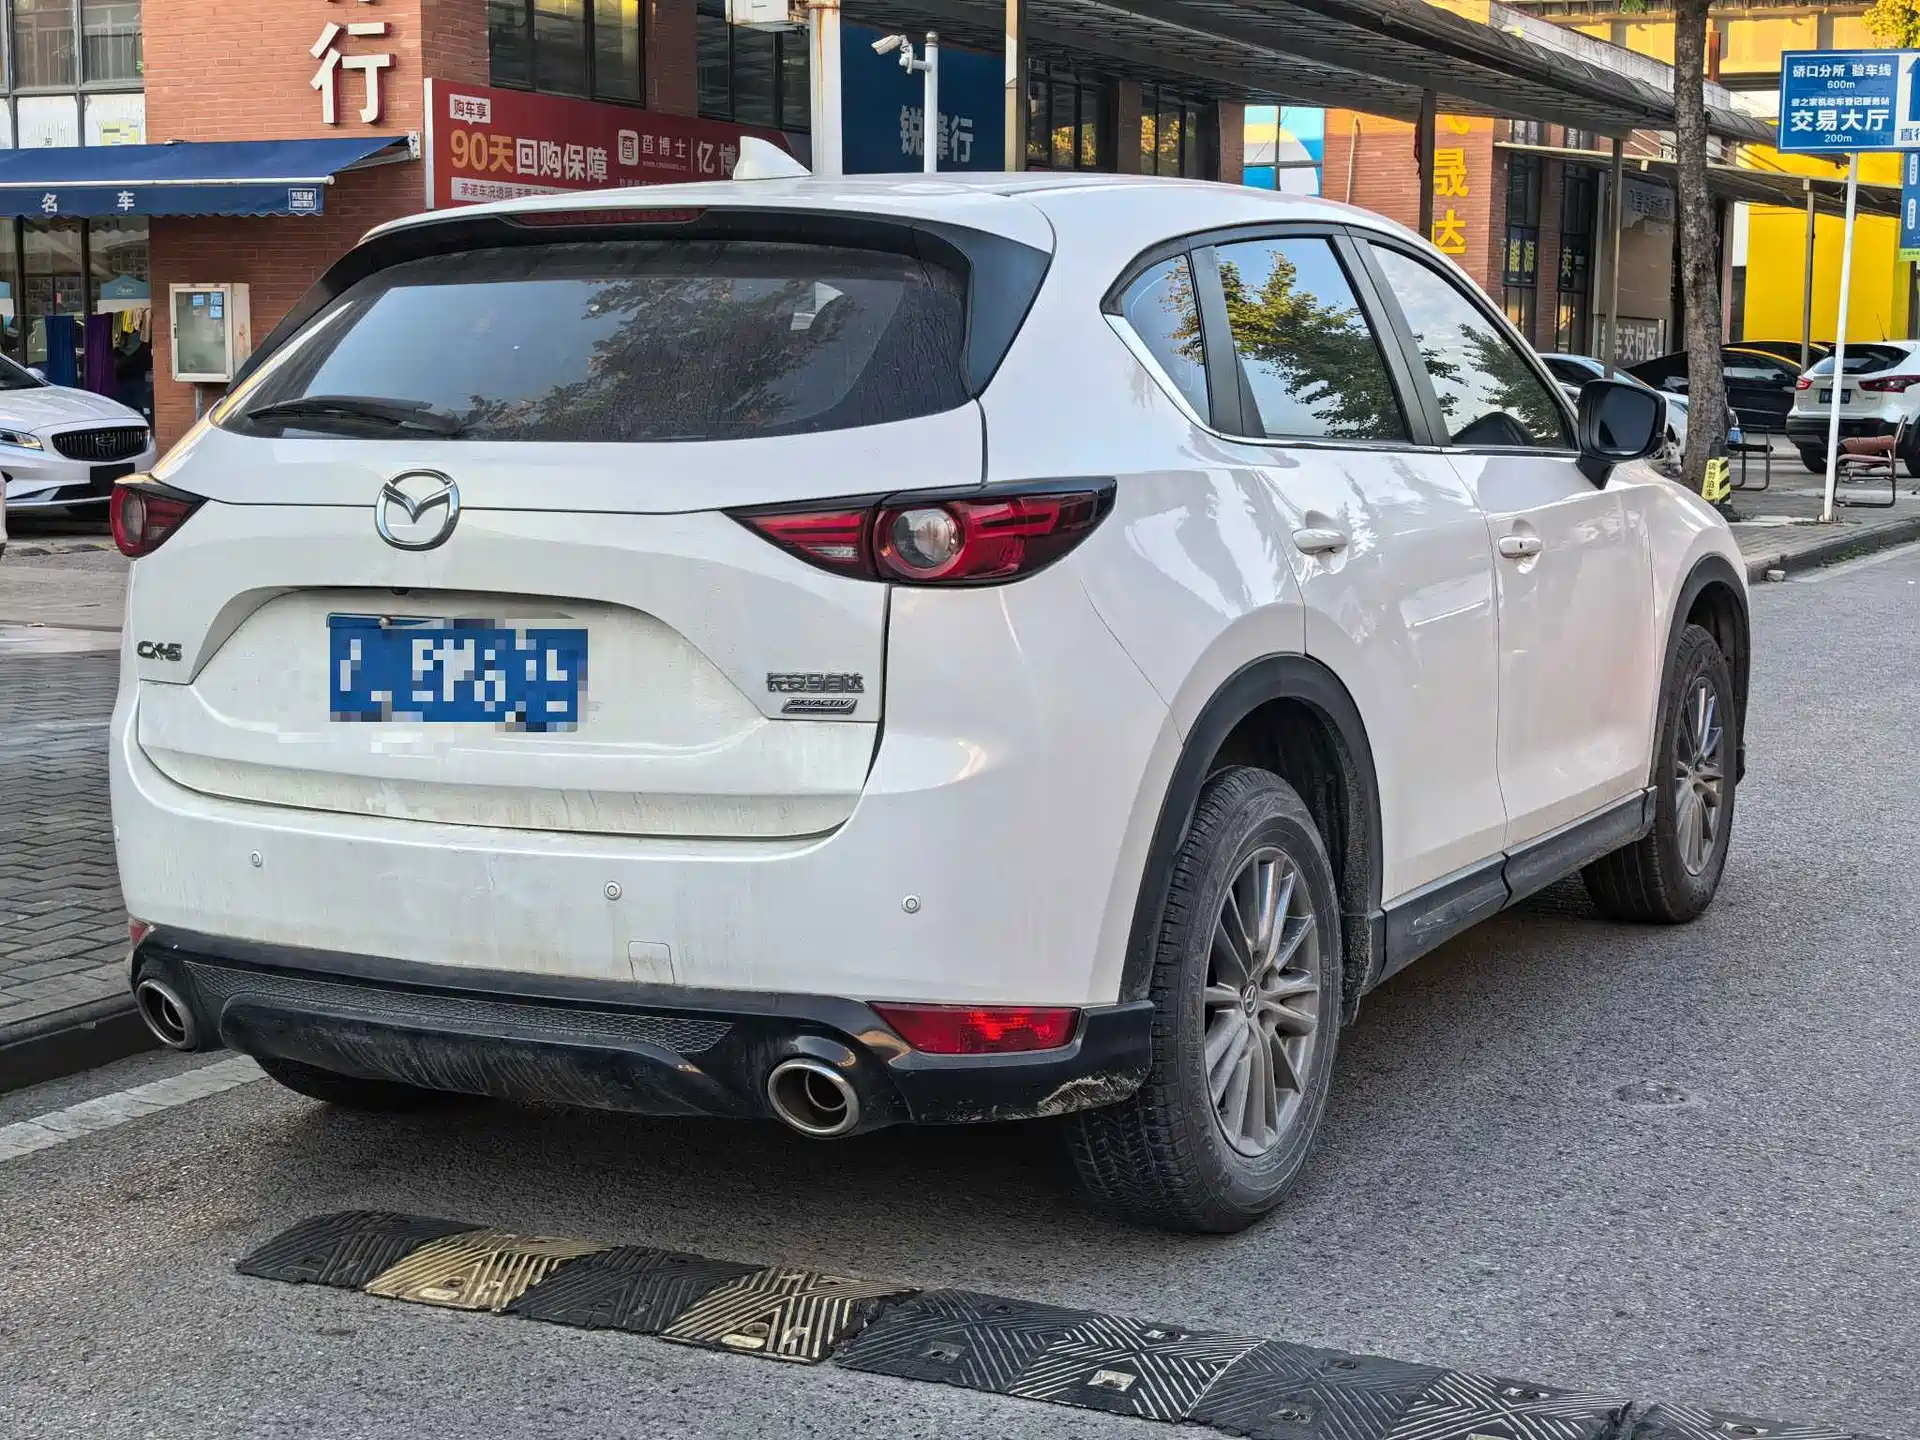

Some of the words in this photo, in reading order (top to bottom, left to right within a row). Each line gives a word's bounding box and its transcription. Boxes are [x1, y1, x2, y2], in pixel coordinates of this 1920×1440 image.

[309, 0, 395, 124] 行
[1792, 64, 1846, 78] 硚口分所
[1851, 63, 1892, 77] 验车线
[1827, 80, 1856, 89] 600m
[454, 99, 488, 120] 购车享
[1790, 108, 1890, 133] 交易大厅
[641, 134, 687, 159] 查博士
[1824, 133, 1853, 143] 200m
[450, 129, 609, 183] 90天回购保障
[136, 640, 183, 661] CX-5
[765, 671, 865, 694] 长安马自达
[789, 698, 850, 707] SKYACTIV
